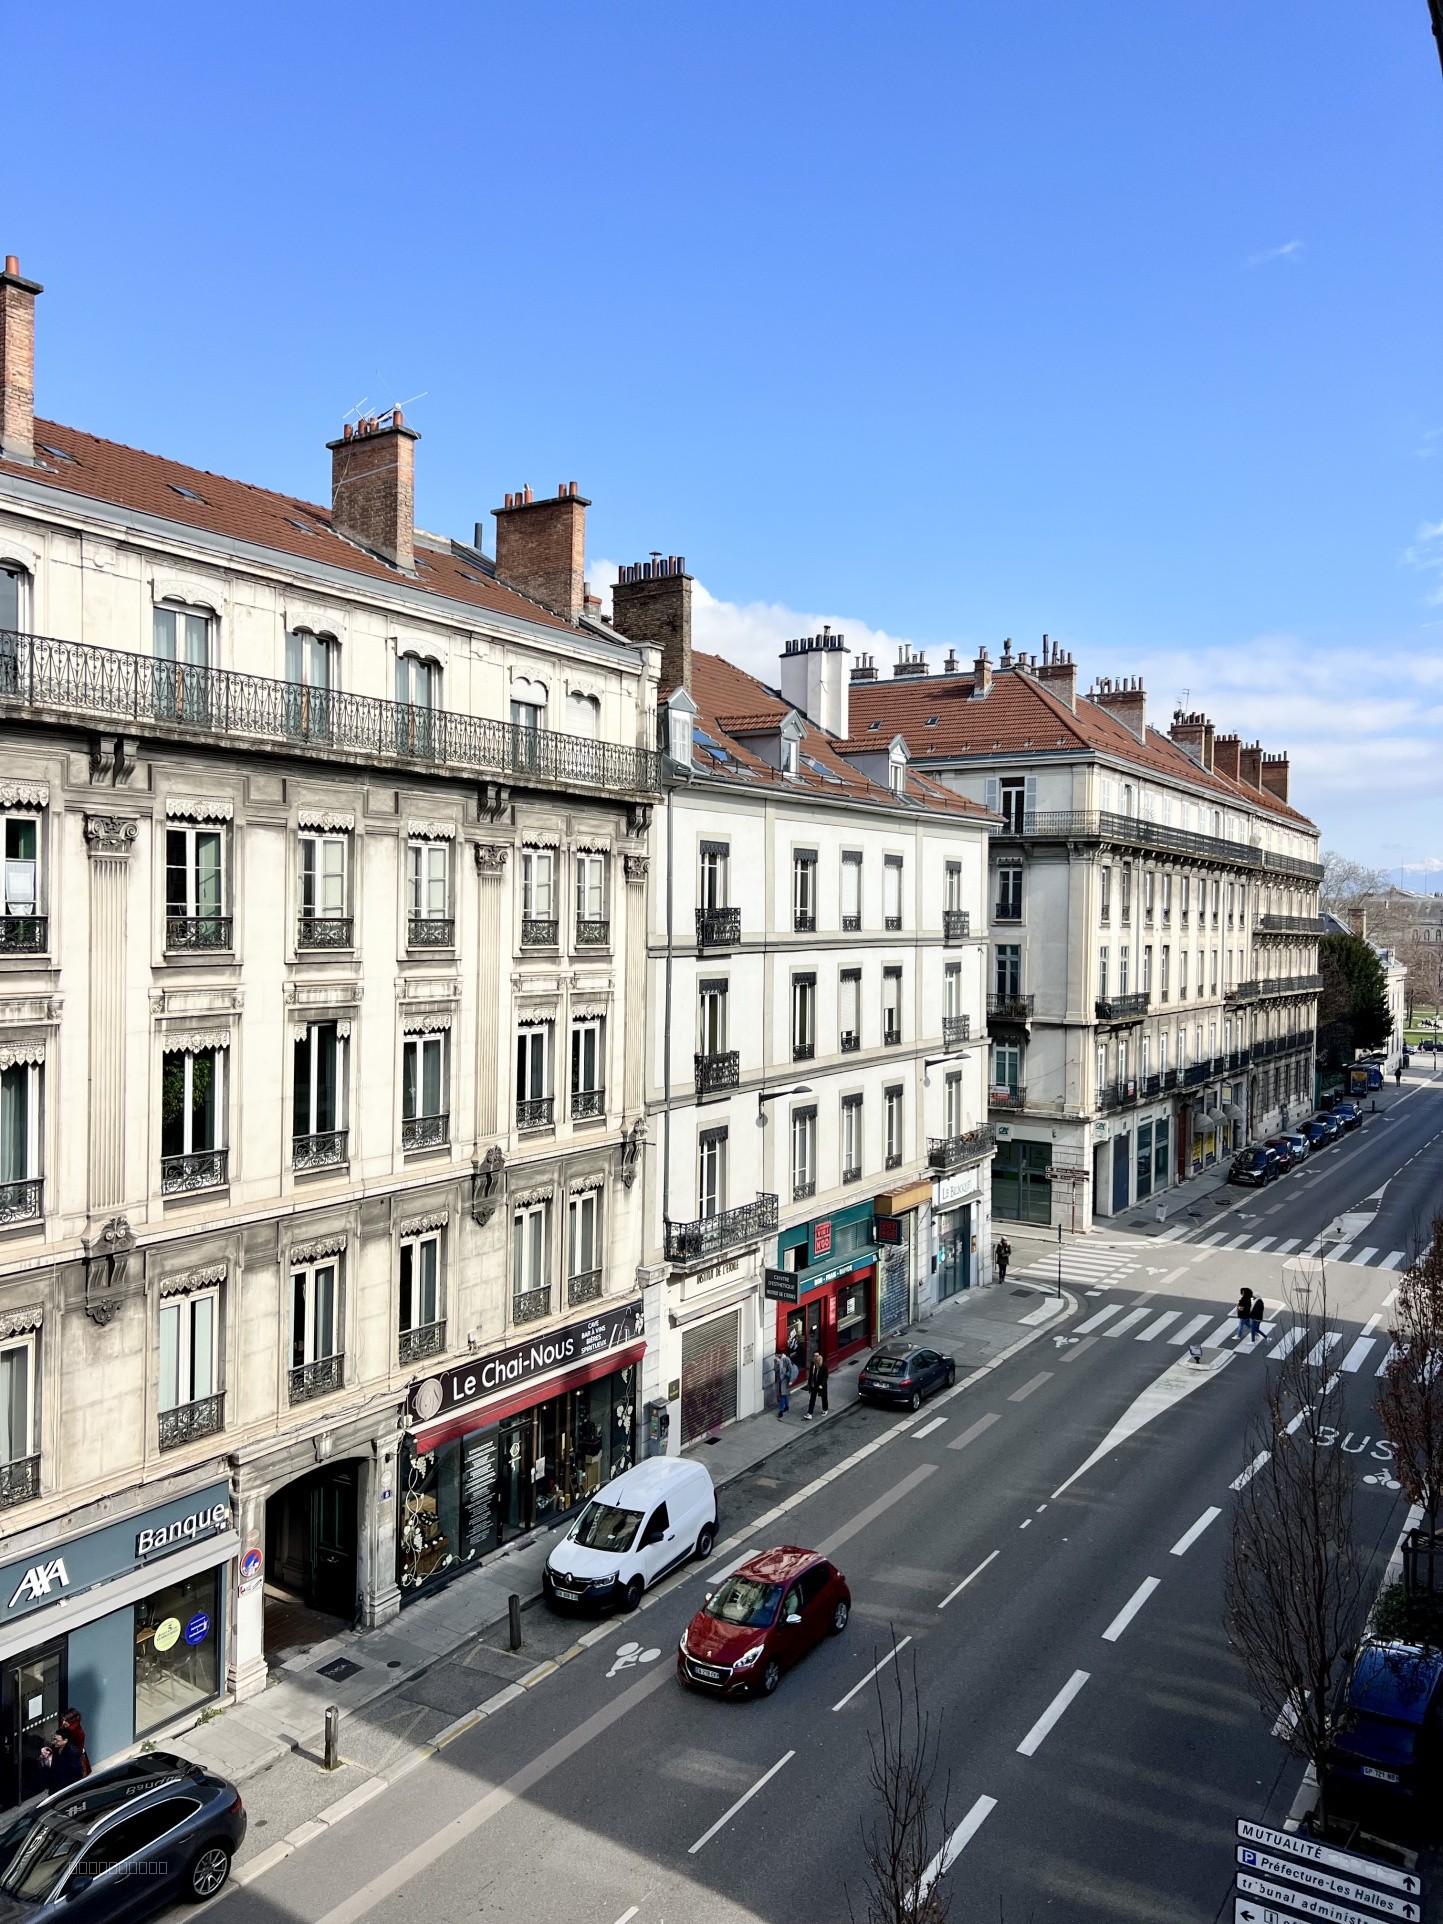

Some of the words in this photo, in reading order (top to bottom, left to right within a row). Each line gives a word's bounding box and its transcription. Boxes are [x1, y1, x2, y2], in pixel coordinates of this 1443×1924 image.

[773, 1274, 790, 1283] CENTRE
[581, 1331, 591, 1340] BAR
[595, 1325, 606, 1334] VINS
[588, 1320, 600, 1329] CAVE
[581, 1339, 607, 1354] SPIRITUEUX
[453, 1376, 477, 1400] Le
[482, 1339, 574, 1388] Chai-Nous
[1309, 1425, 1400, 1460] BUS
[138, 1502, 226, 1556] Banque
[8, 1557, 70, 1608] AXA
[1242, 1824, 1323, 1859] MUTUALITÉ
[1242, 1879, 1296, 1904] trbunal
[1260, 1857, 1351, 1896] Préfecture-Les
[1354, 1888, 1394, 1910] Halles
